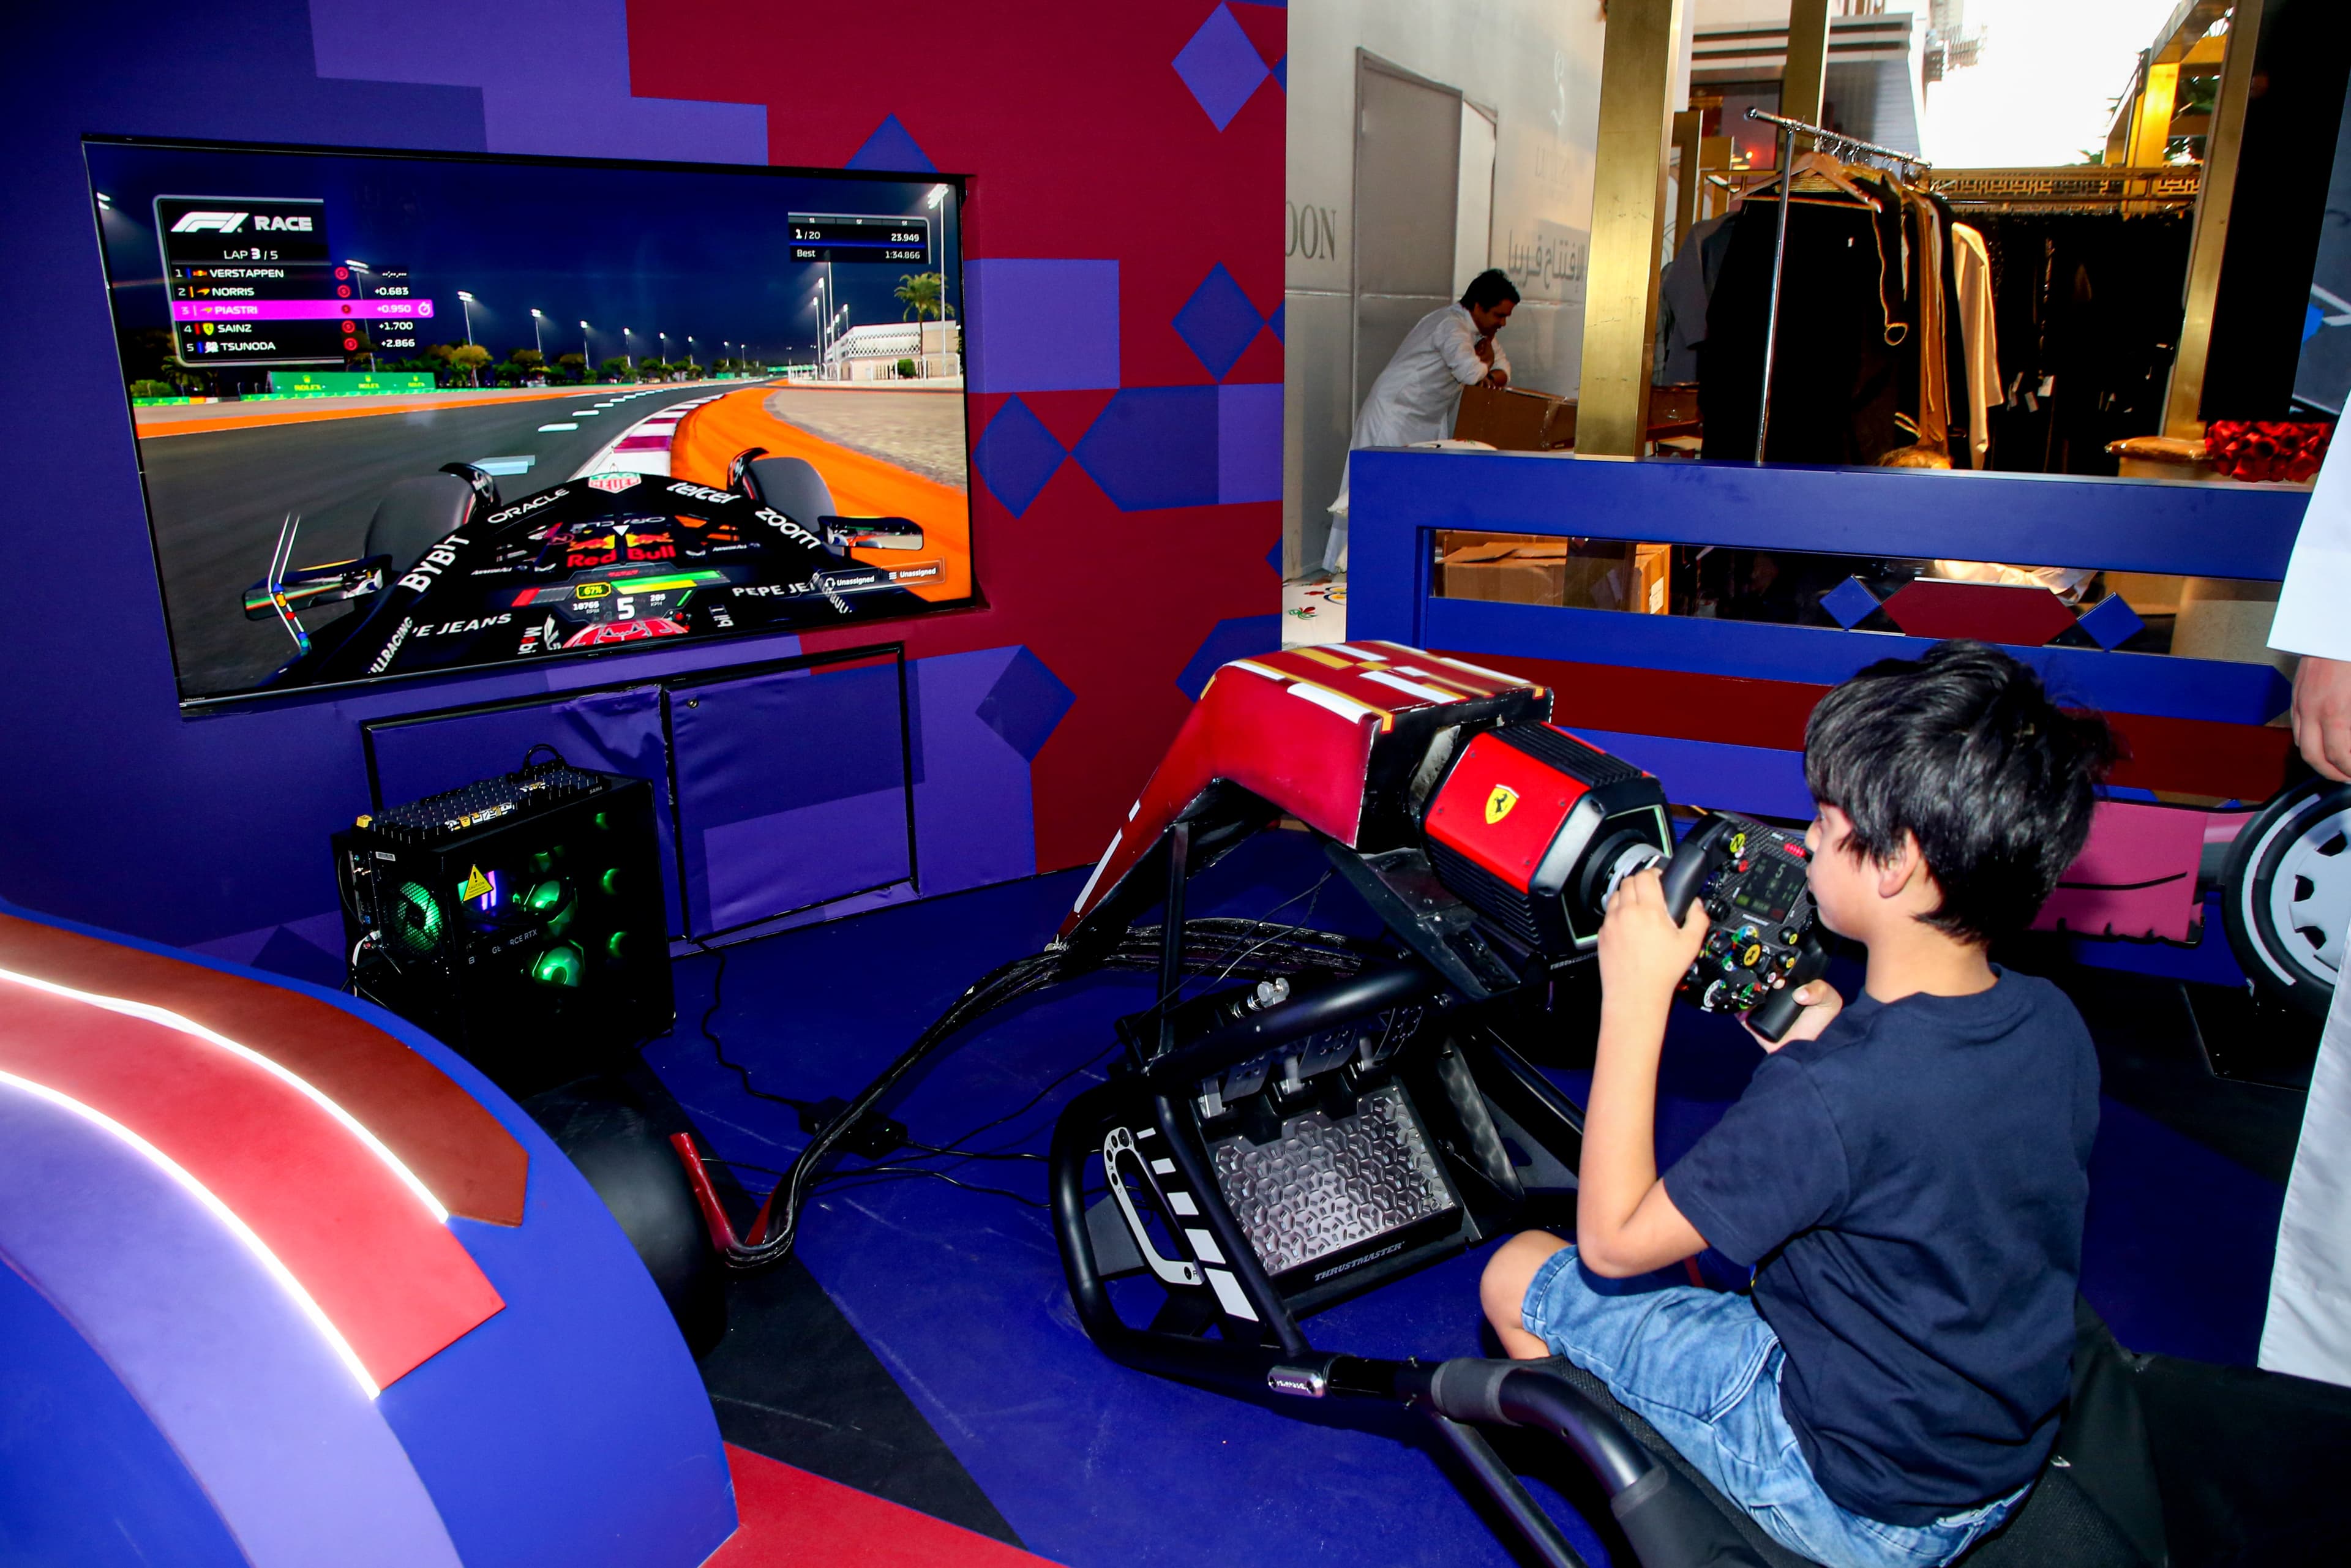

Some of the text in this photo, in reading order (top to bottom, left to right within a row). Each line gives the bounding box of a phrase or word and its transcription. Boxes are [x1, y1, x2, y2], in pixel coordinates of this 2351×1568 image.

[254, 216, 313, 231] RACE
[891, 233, 920, 242] 23.949
[223, 250, 248, 260] LAP
[250, 247, 261, 260] 3
[270, 250, 279, 260] 5
[797, 249, 816, 258] Best
[175, 269, 183, 278] 1
[209, 269, 284, 278] VERSTAPPEN
[178, 288, 186, 296] 2
[212, 287, 255, 296] NORRIS
[375, 287, 409, 296] +0.683
[181, 306, 190, 315] 3
[214, 306, 258, 315] PIASTRI
[377, 304, 411, 313] +0.950
[217, 324, 252, 333] SAINZ
[379, 322, 413, 331] +1.700
[186, 343, 195, 352] 5
[220, 342, 276, 351] TSUNODA
[381, 339, 416, 348] +2.866
[590, 478, 640, 490] HEUER
[666, 482, 741, 504] telcel
[487, 488, 569, 523] ORACLE
[755, 507, 821, 549] zoom
[566, 544, 677, 568] Red Bull
[398, 534, 470, 594] BYBIT
[899, 568, 936, 579] Unassigned
[837, 576, 875, 586] Unassigned
[583, 586, 603, 596] 67%
[732, 585, 785, 596] PEPE
[617, 597, 636, 621] 5
[436, 613, 512, 635] JEANS
[468, 881, 486, 890] CAUTION
[492, 929, 538, 955] GERCE RTX
[1314, 1242, 1403, 1282] THRUSTMASTER
